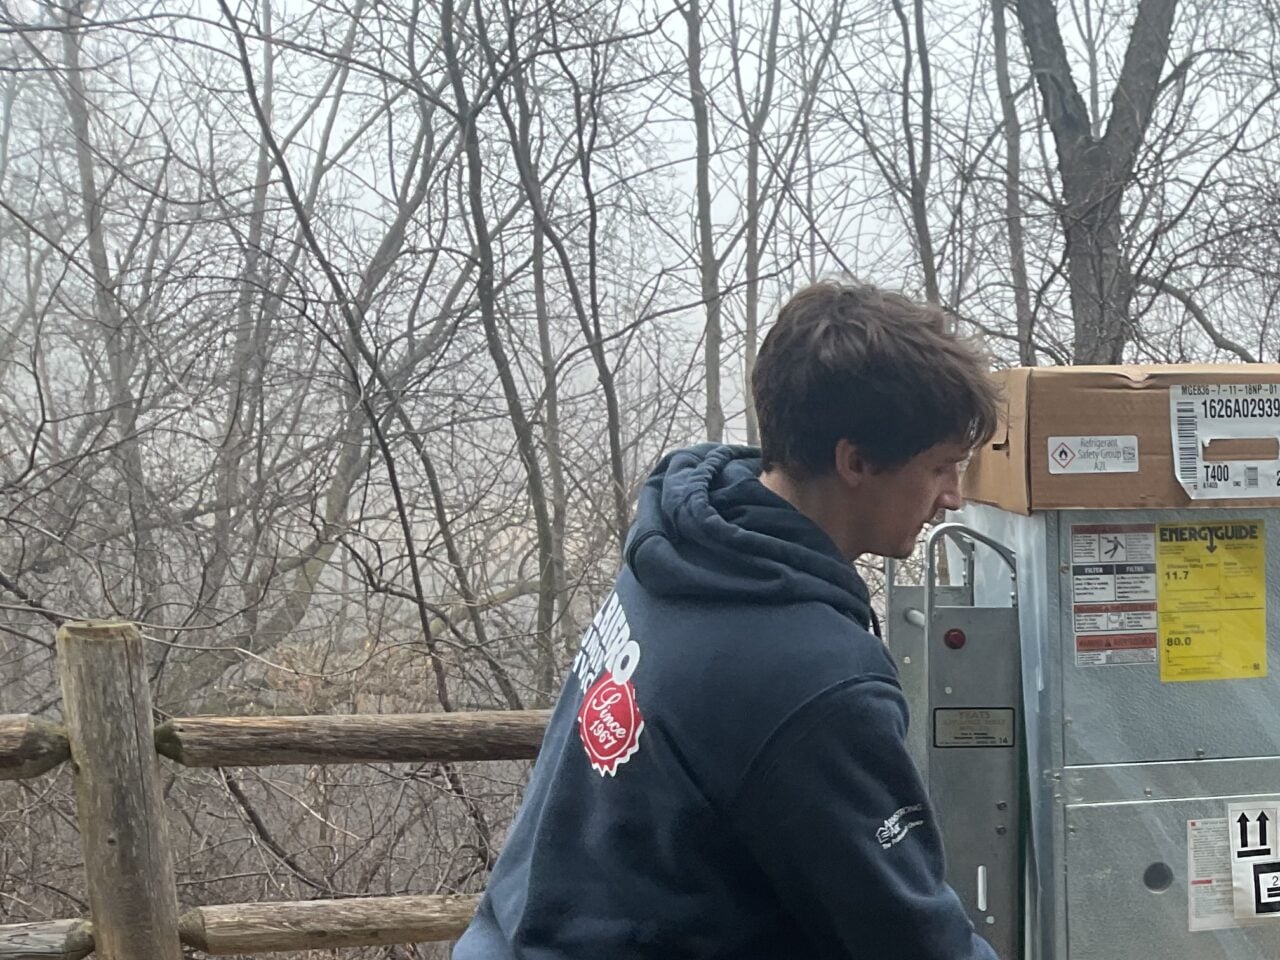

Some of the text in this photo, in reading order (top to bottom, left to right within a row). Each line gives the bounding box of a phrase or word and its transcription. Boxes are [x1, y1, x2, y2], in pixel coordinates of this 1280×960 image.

[1201, 398, 1280, 419] 1626A02939
[1080, 438, 1118, 449] Refrigerant
[1078, 449, 1121, 460] Safety Group
[1203, 465, 1229, 482] T400
[1165, 571, 1189, 580] 11.7
[1166, 637, 1191, 646] 80.0
[591, 687, 627, 739] Since
[589, 720, 617, 750] 1967
[1272, 875, 1280, 887] 2
